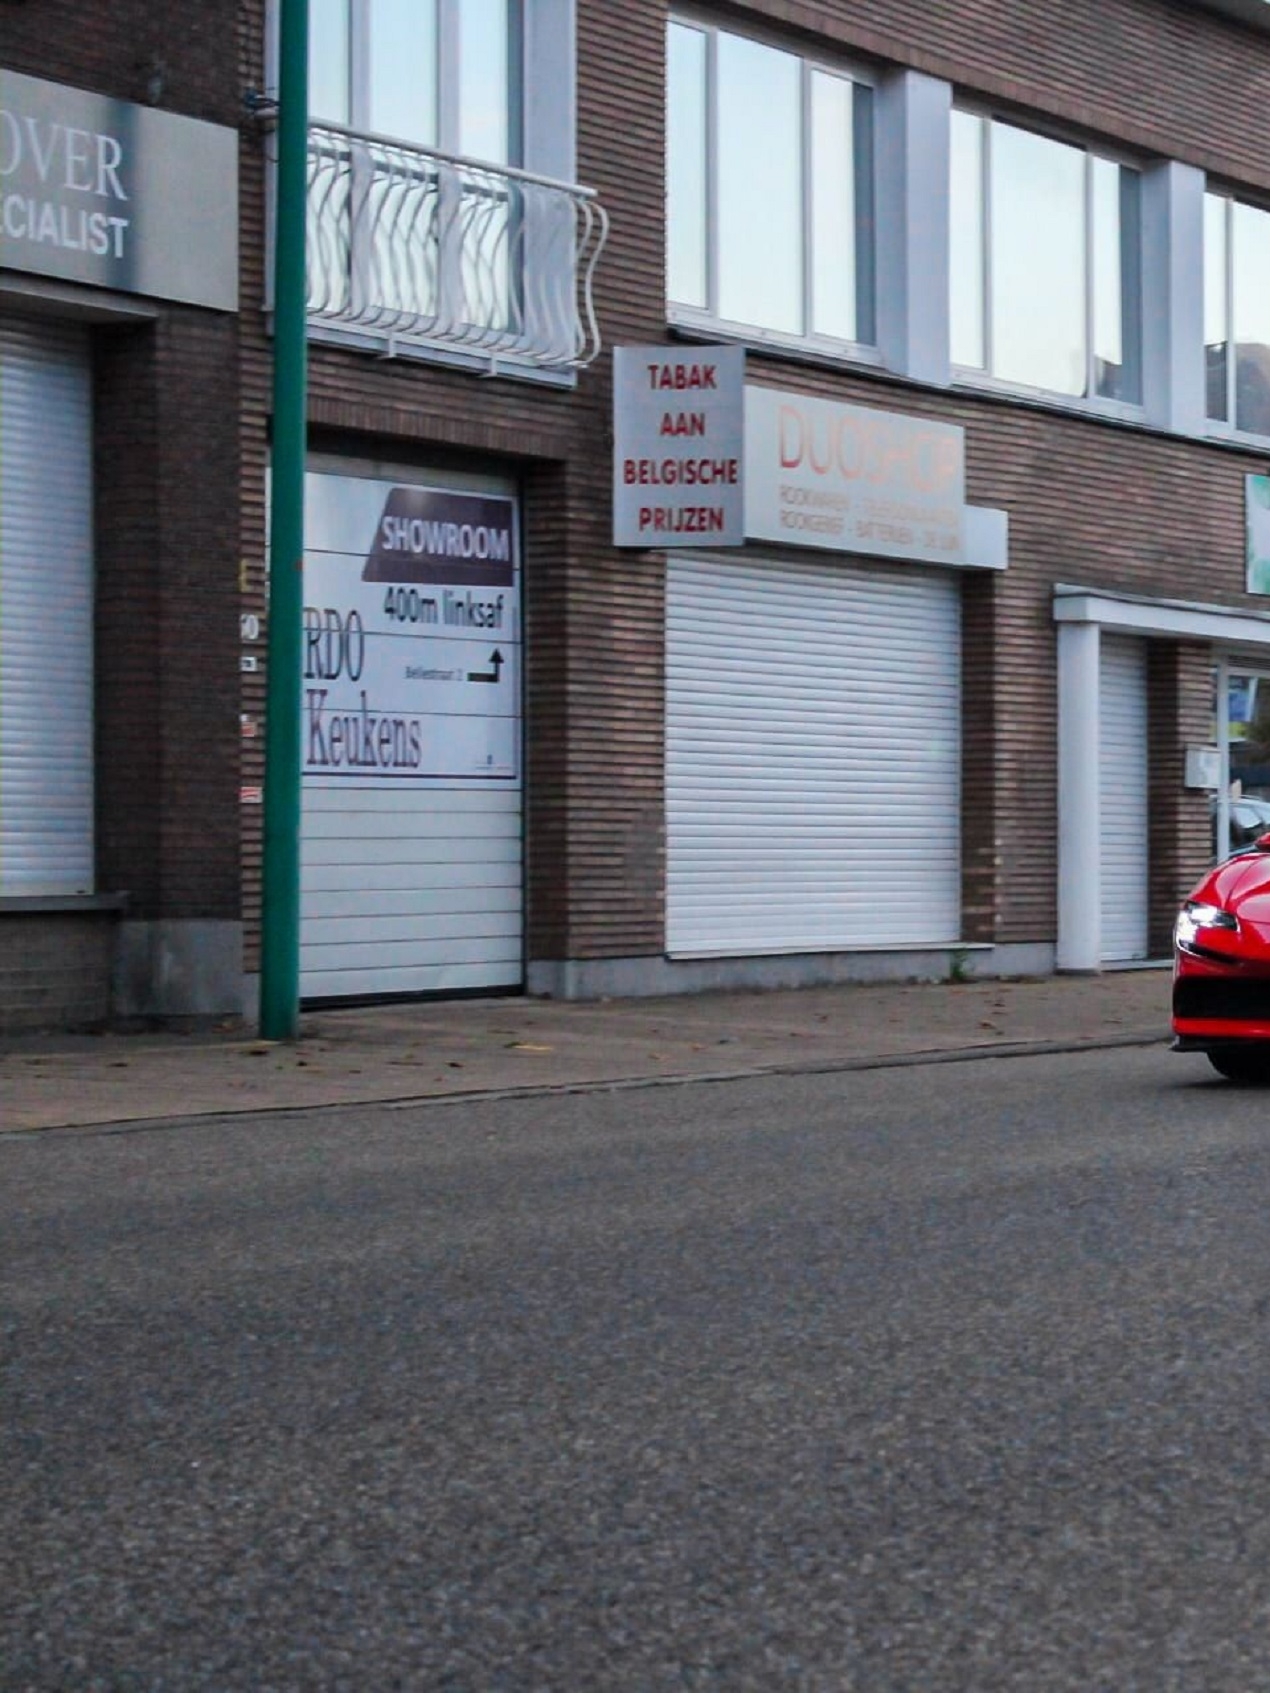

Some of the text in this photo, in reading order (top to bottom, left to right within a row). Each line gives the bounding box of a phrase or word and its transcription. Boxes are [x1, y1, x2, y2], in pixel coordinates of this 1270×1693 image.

[0, 193, 130, 259] CIALIST
[648, 364, 717, 390] TABAK
[660, 412, 705, 436] AAN
[623, 459, 738, 485] BELGISCHE
[639, 507, 724, 533] PRIJZEN
[382, 515, 510, 562] SHOWROOM
[385, 587, 504, 629] 400m linksaf
[305, 689, 422, 769] Keukens
